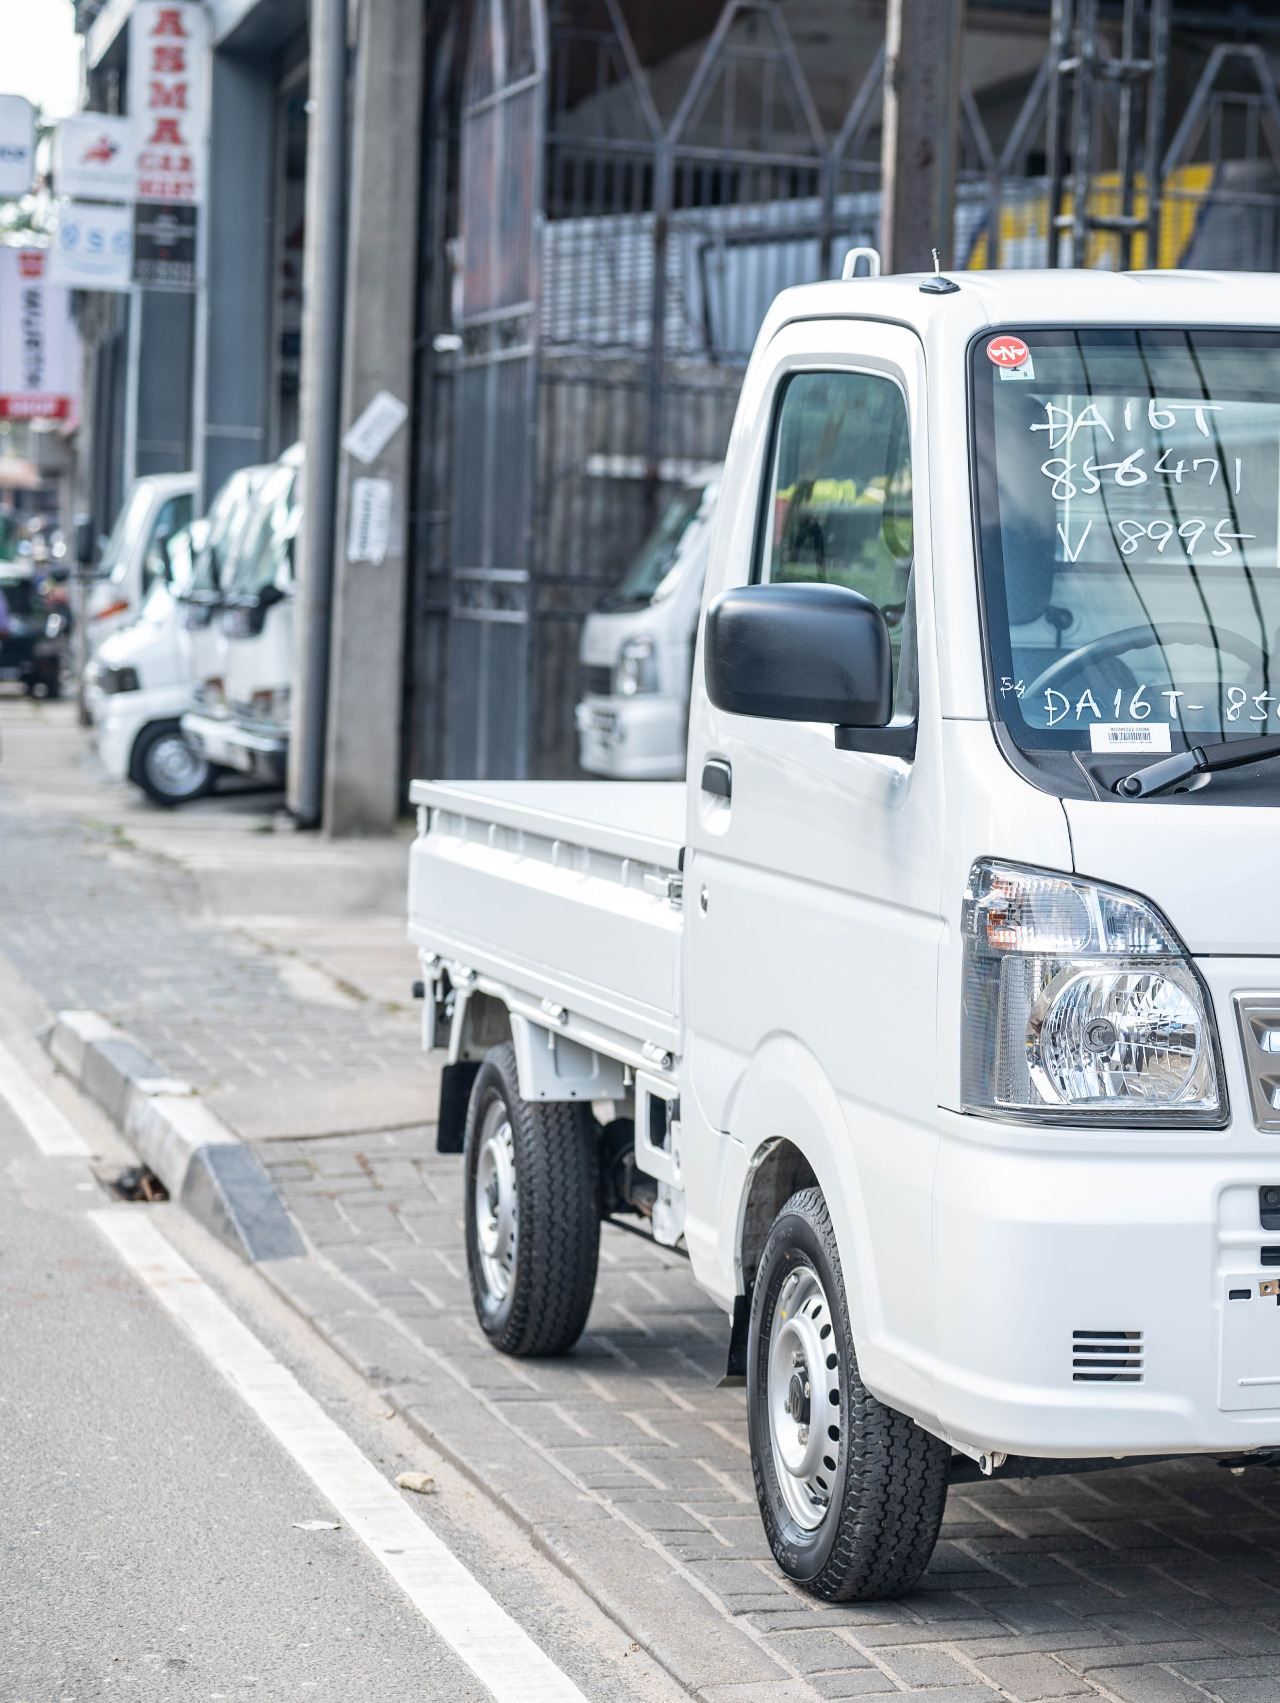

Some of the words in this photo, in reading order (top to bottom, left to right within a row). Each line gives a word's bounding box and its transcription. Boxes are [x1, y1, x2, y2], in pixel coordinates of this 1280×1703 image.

[150, 9, 187, 146] ASMA
[1029, 398, 1224, 450] DA16T
[1040, 447, 1242, 501] 856471
[1056, 519, 1093, 563] V
[1117, 518, 1257, 557] 8995
